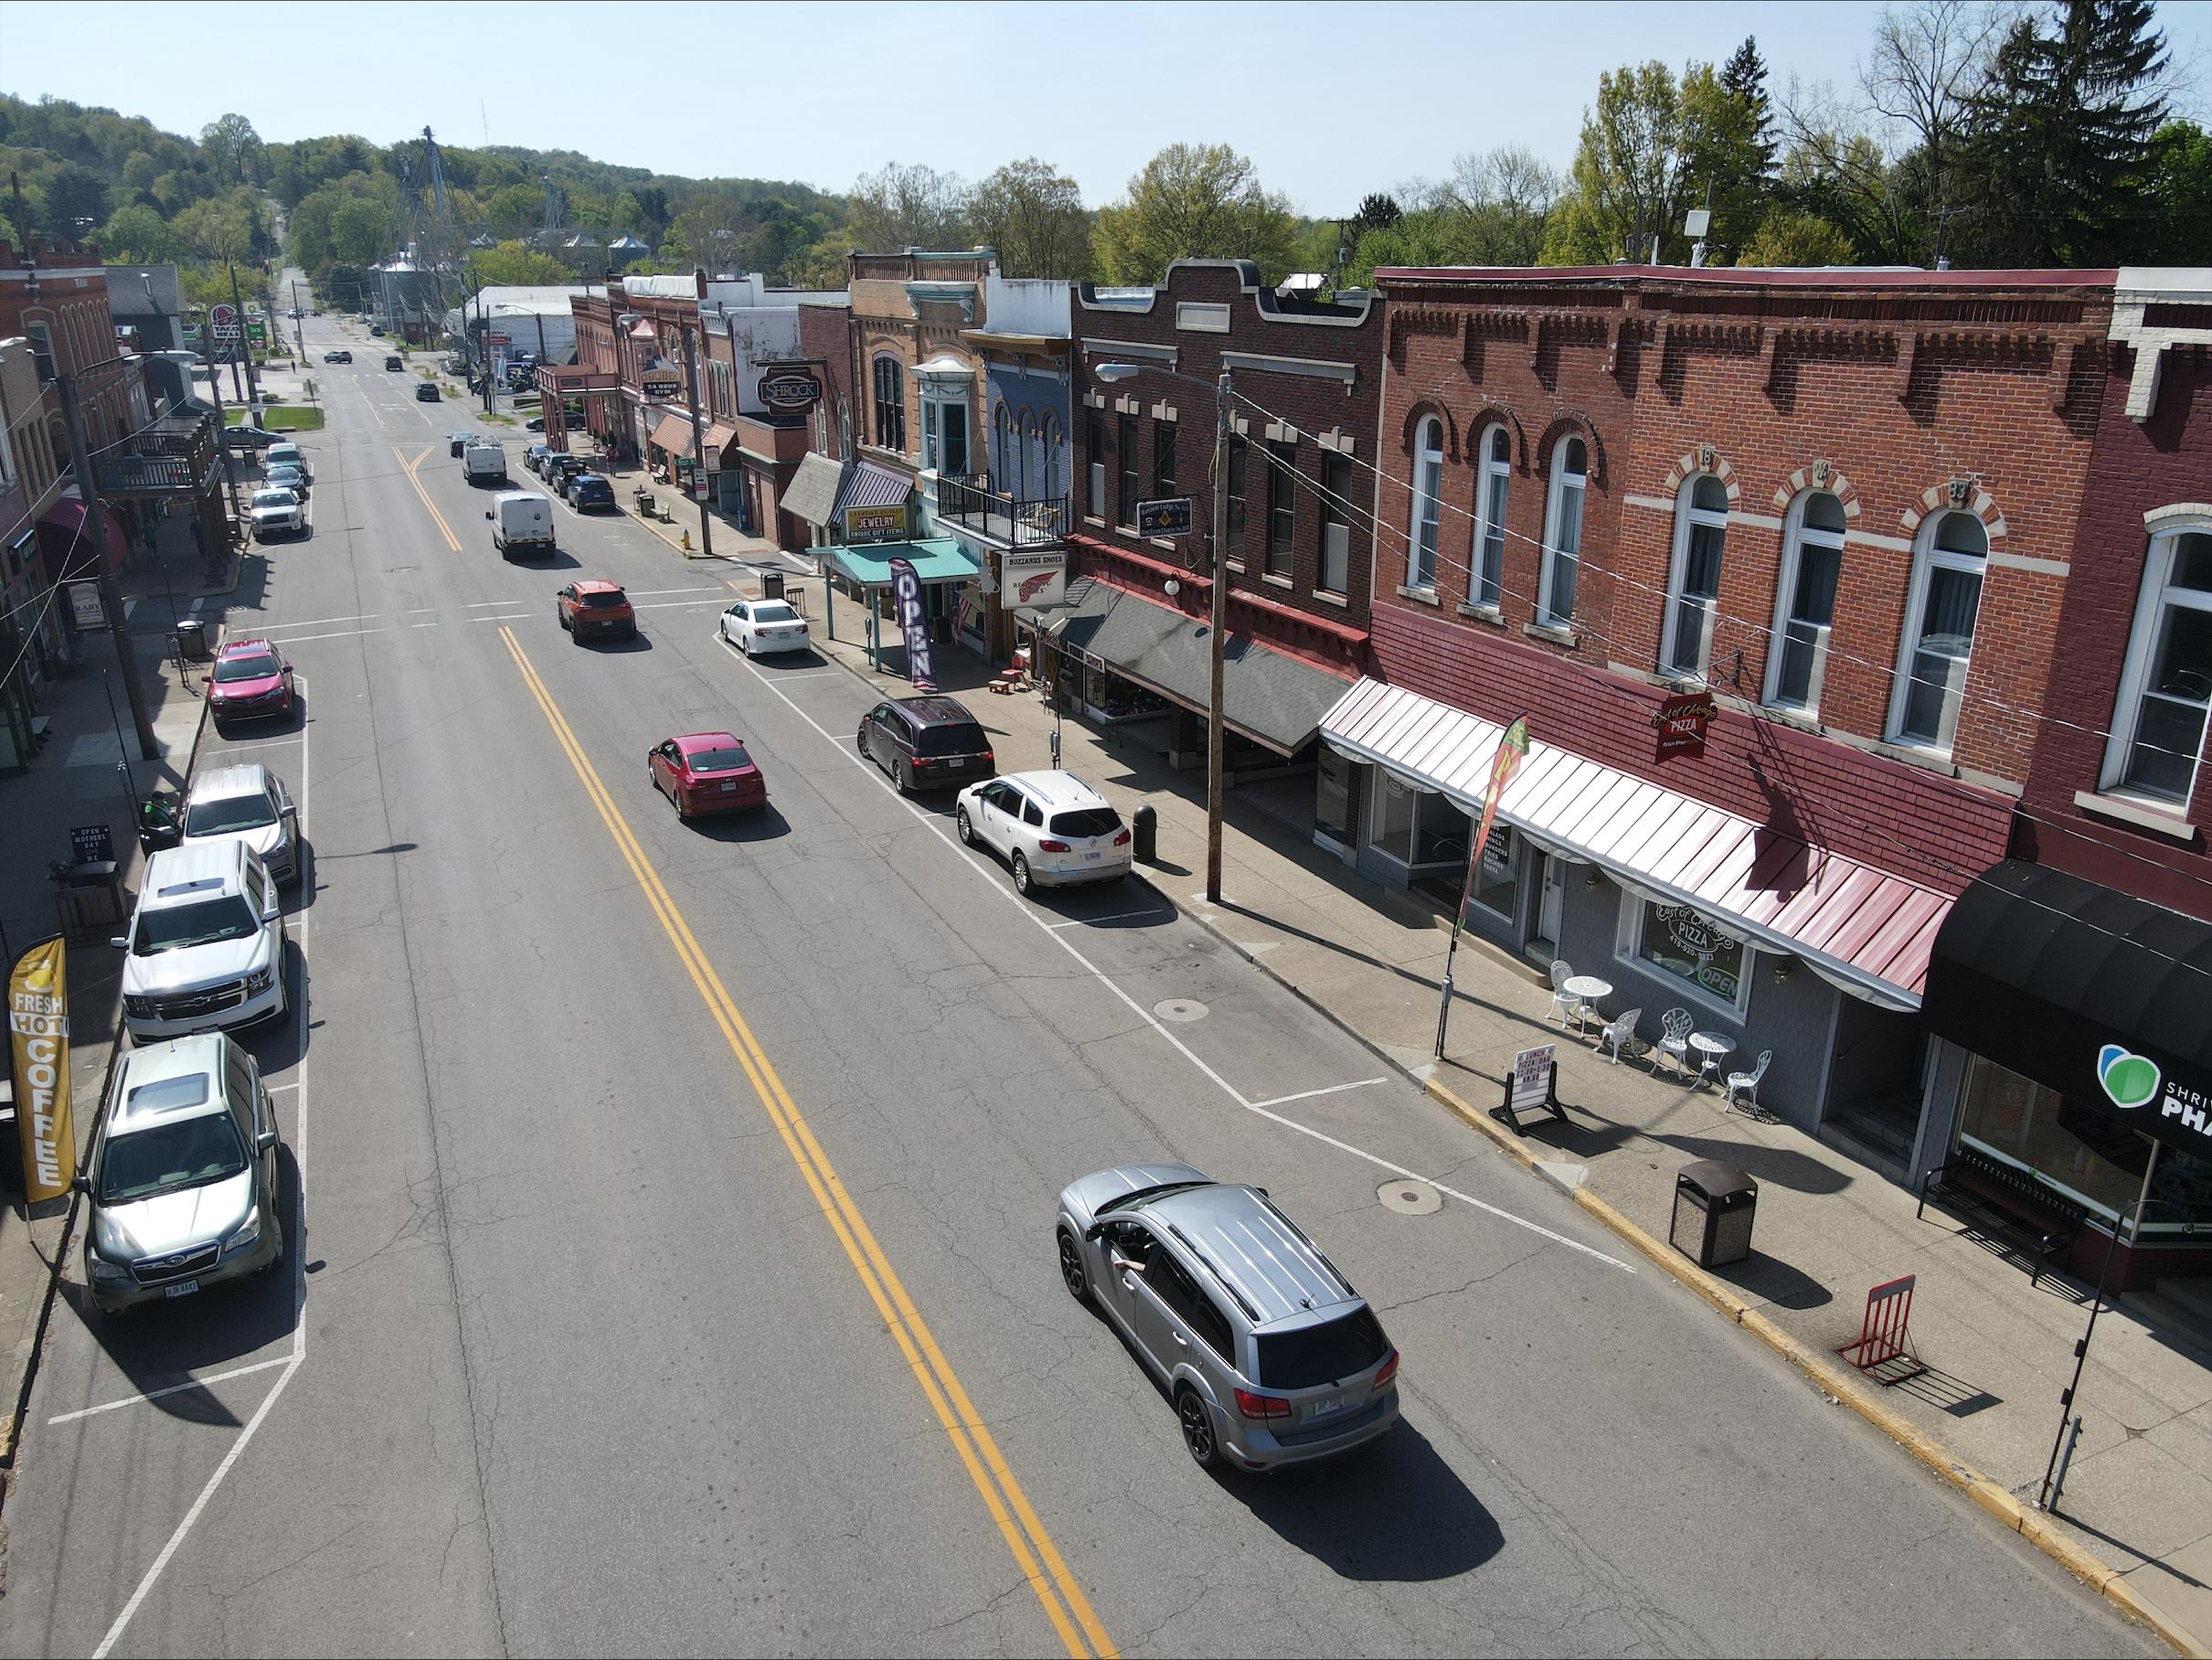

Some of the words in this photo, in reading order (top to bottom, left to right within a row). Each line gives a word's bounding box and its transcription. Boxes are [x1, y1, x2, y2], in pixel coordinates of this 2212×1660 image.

[766, 383, 814, 399] SHROCK
[858, 516, 894, 528] JEWELRY
[1009, 557, 1041, 566] BUZZARDS
[1042, 556, 1063, 564] SHOES
[898, 574, 931, 676] OPEN
[1671, 718, 1697, 733] PIZZA
[1483, 862, 1499, 875] PASTA
[1678, 921, 1708, 949] PIZZA
[1701, 968, 1739, 996] OPEN
[15, 993, 63, 1015] FRESH
[16, 1015, 64, 1034] HOT
[1526, 1049, 1546, 1060] LUNCH
[1517, 1059, 1535, 1069] PIZZA
[2166, 1081, 2212, 1109] SHRI
[27, 1039, 62, 1186] COFFEE
